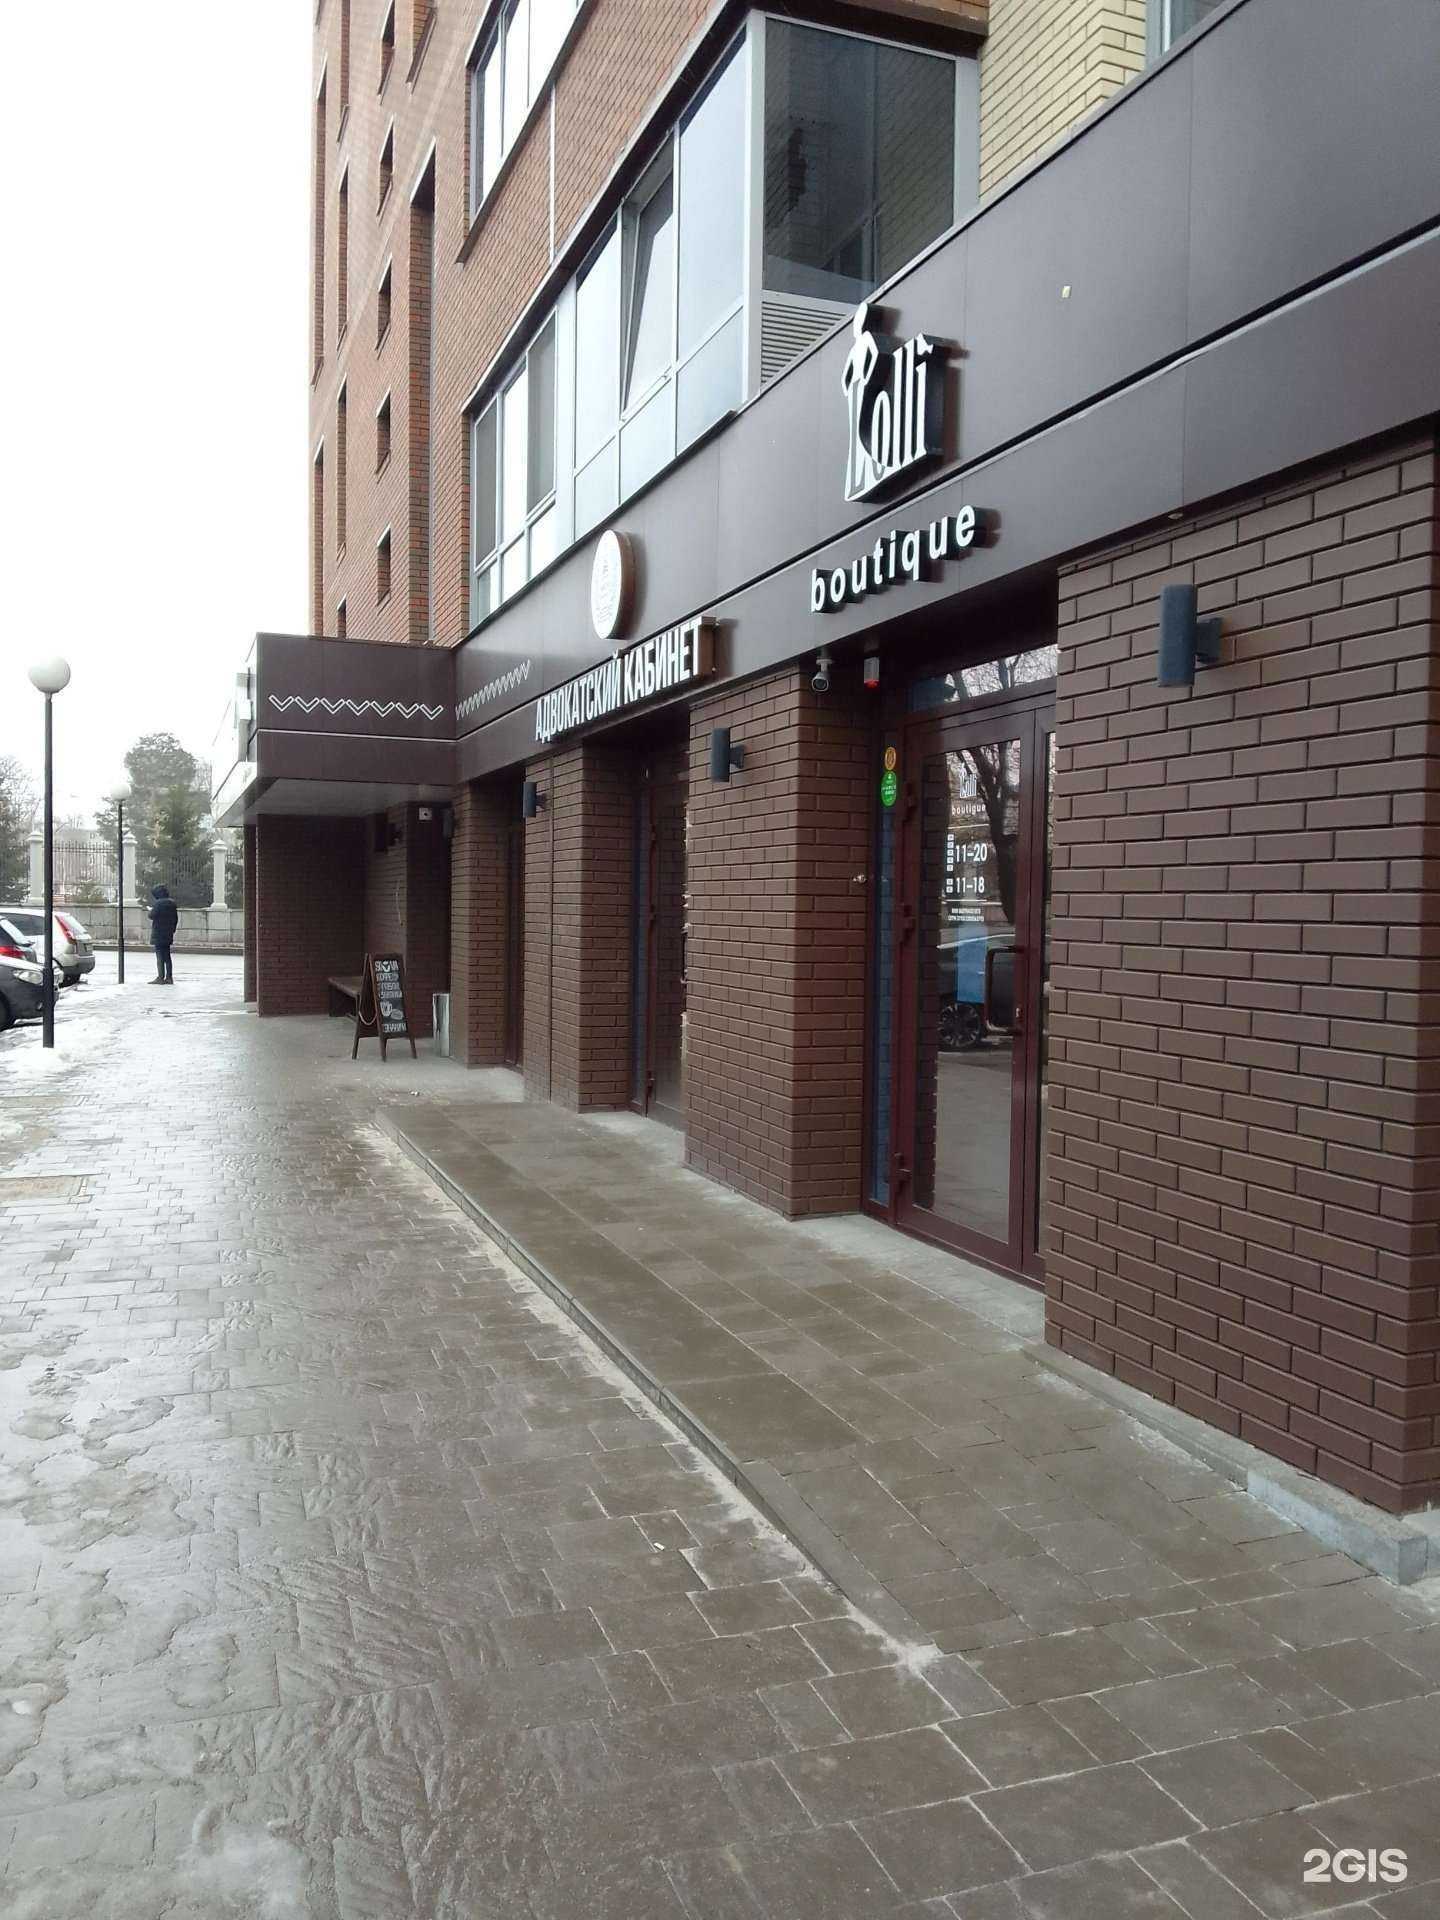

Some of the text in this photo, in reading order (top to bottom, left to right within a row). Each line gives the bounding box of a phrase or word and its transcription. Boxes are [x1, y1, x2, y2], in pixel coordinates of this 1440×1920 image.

[810, 505, 976, 613] boutique
[535, 618, 702, 744] АДВОКАТСКИЙ КАБИНЕТ
